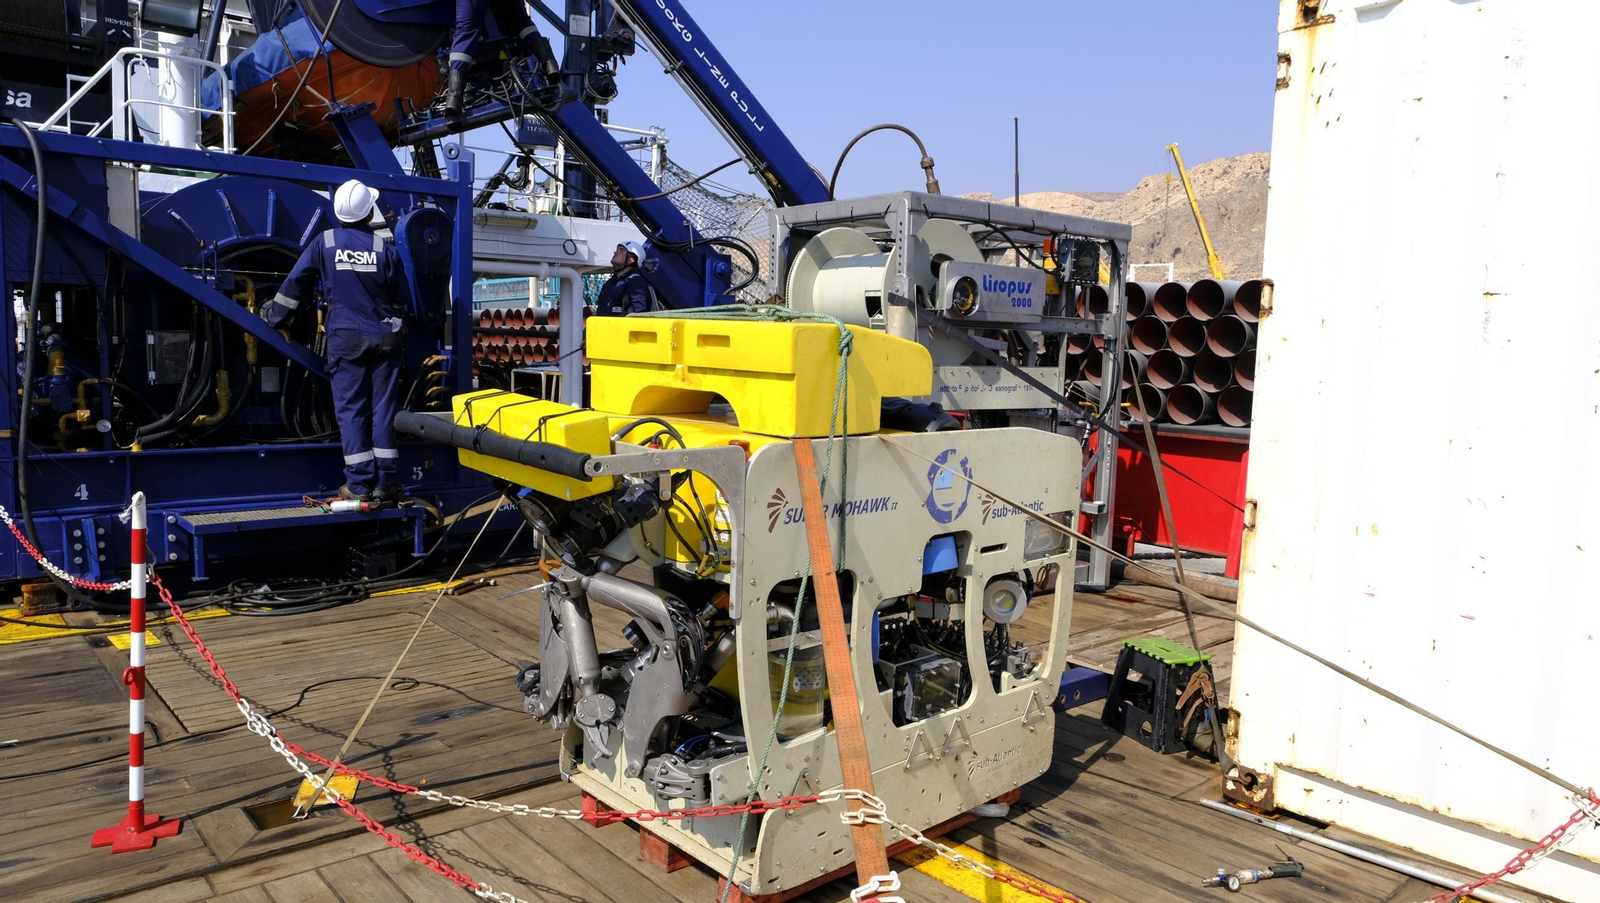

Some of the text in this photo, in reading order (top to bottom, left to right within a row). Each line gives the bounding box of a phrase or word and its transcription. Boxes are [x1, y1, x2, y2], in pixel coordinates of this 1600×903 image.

[694, 48, 729, 88] LINE
[731, 91, 764, 132] PULL
[335, 249, 377, 265] ACSM
[983, 274, 1032, 297] Liropus
[1011, 297, 1032, 308] 2000
[413, 466, 423, 480] 5
[74, 484, 88, 500] 4
[498, 503, 519, 512] LAR
[784, 504, 829, 525] SUR
[831, 496, 890, 518] MOHAWK
